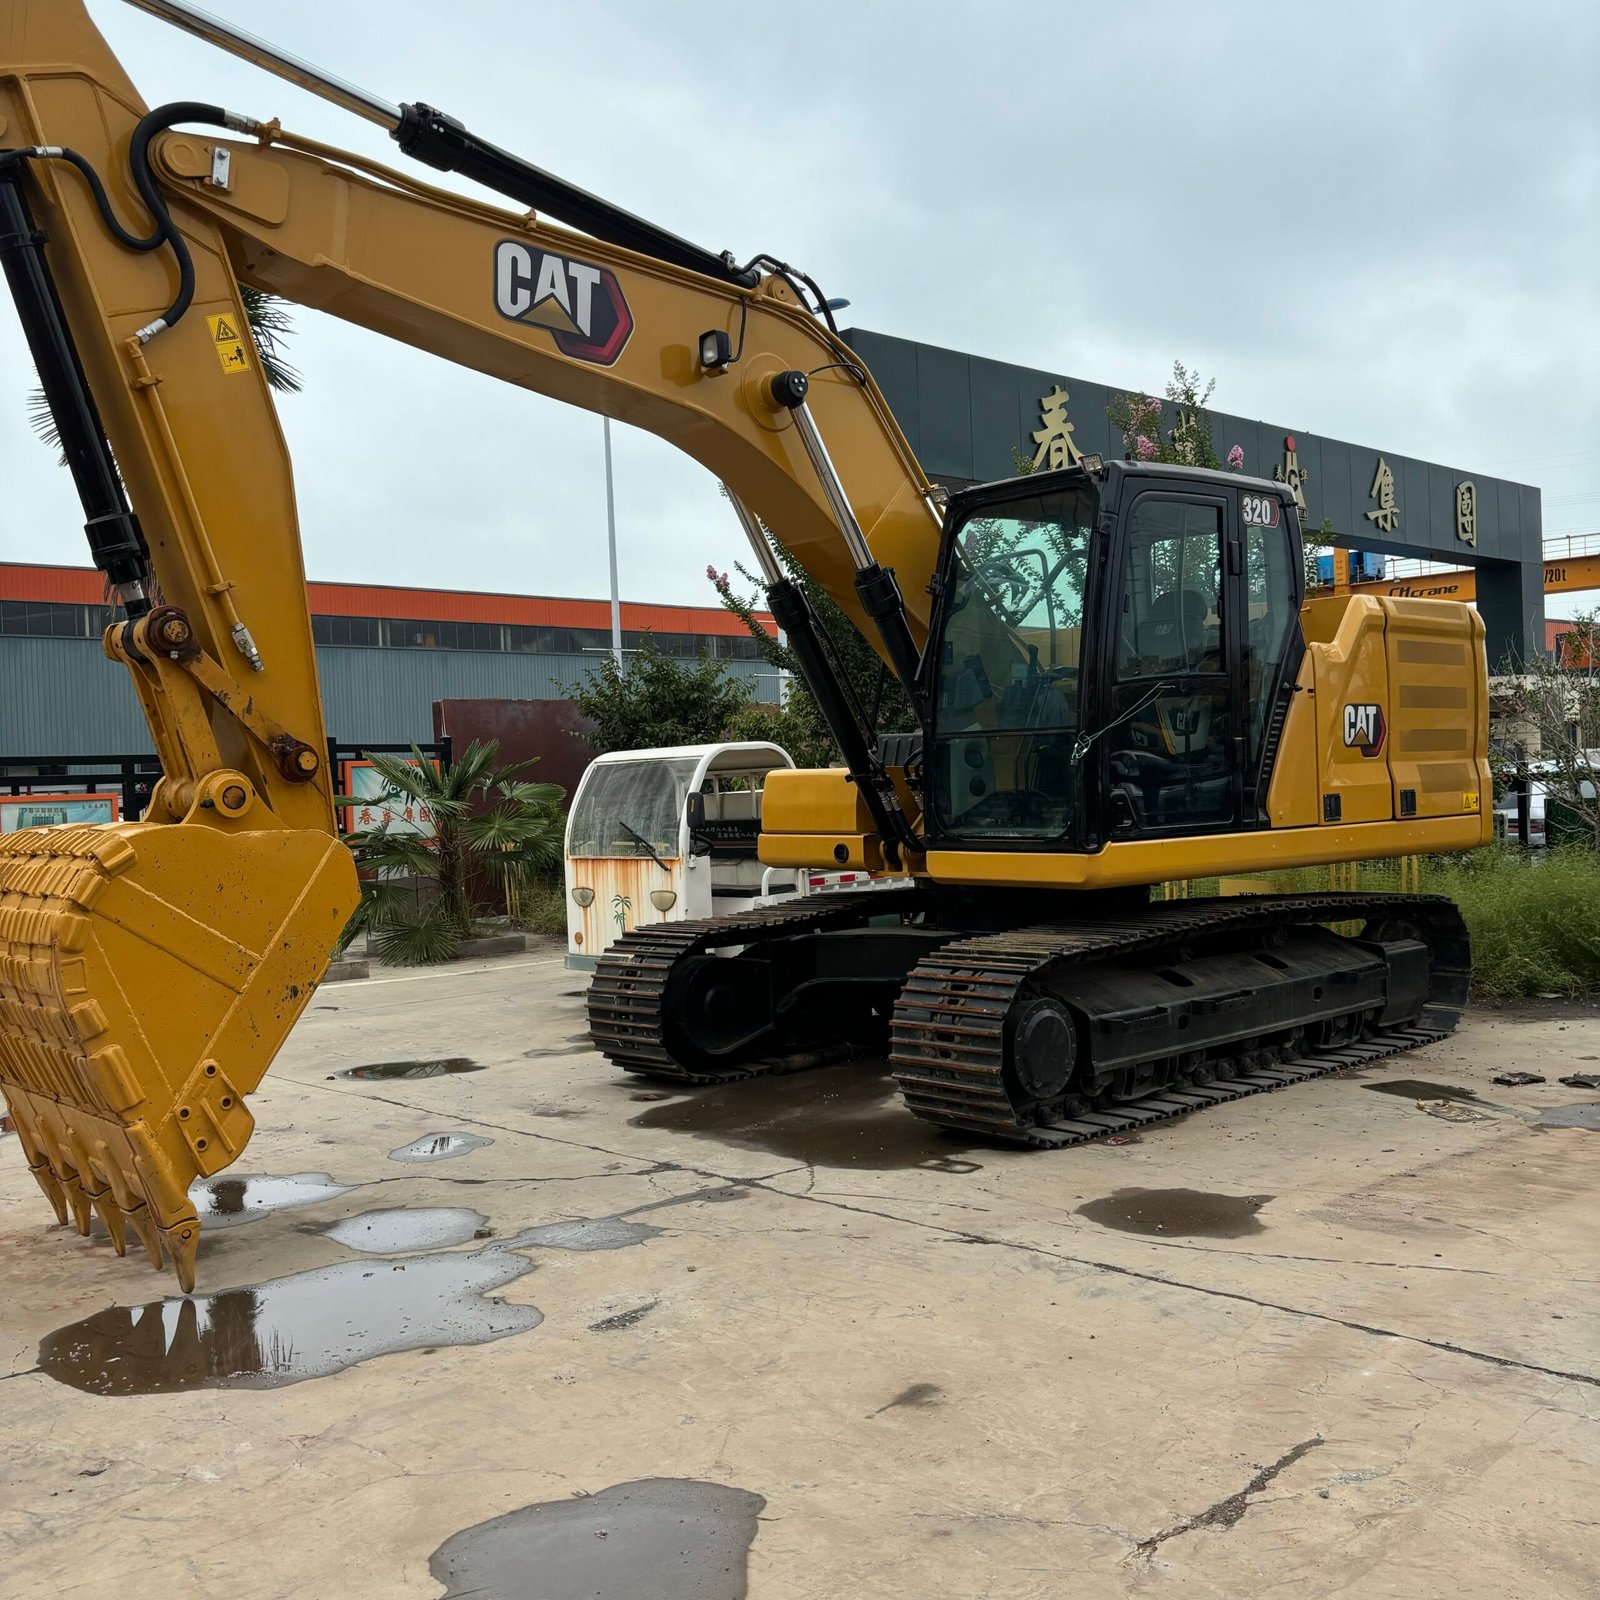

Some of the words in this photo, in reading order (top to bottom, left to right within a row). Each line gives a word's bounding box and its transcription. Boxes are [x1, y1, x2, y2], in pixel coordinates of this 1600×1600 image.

[497, 242, 600, 337] CAT
[1243, 496, 1271, 525] 320
[1344, 704, 1377, 746] CAT
